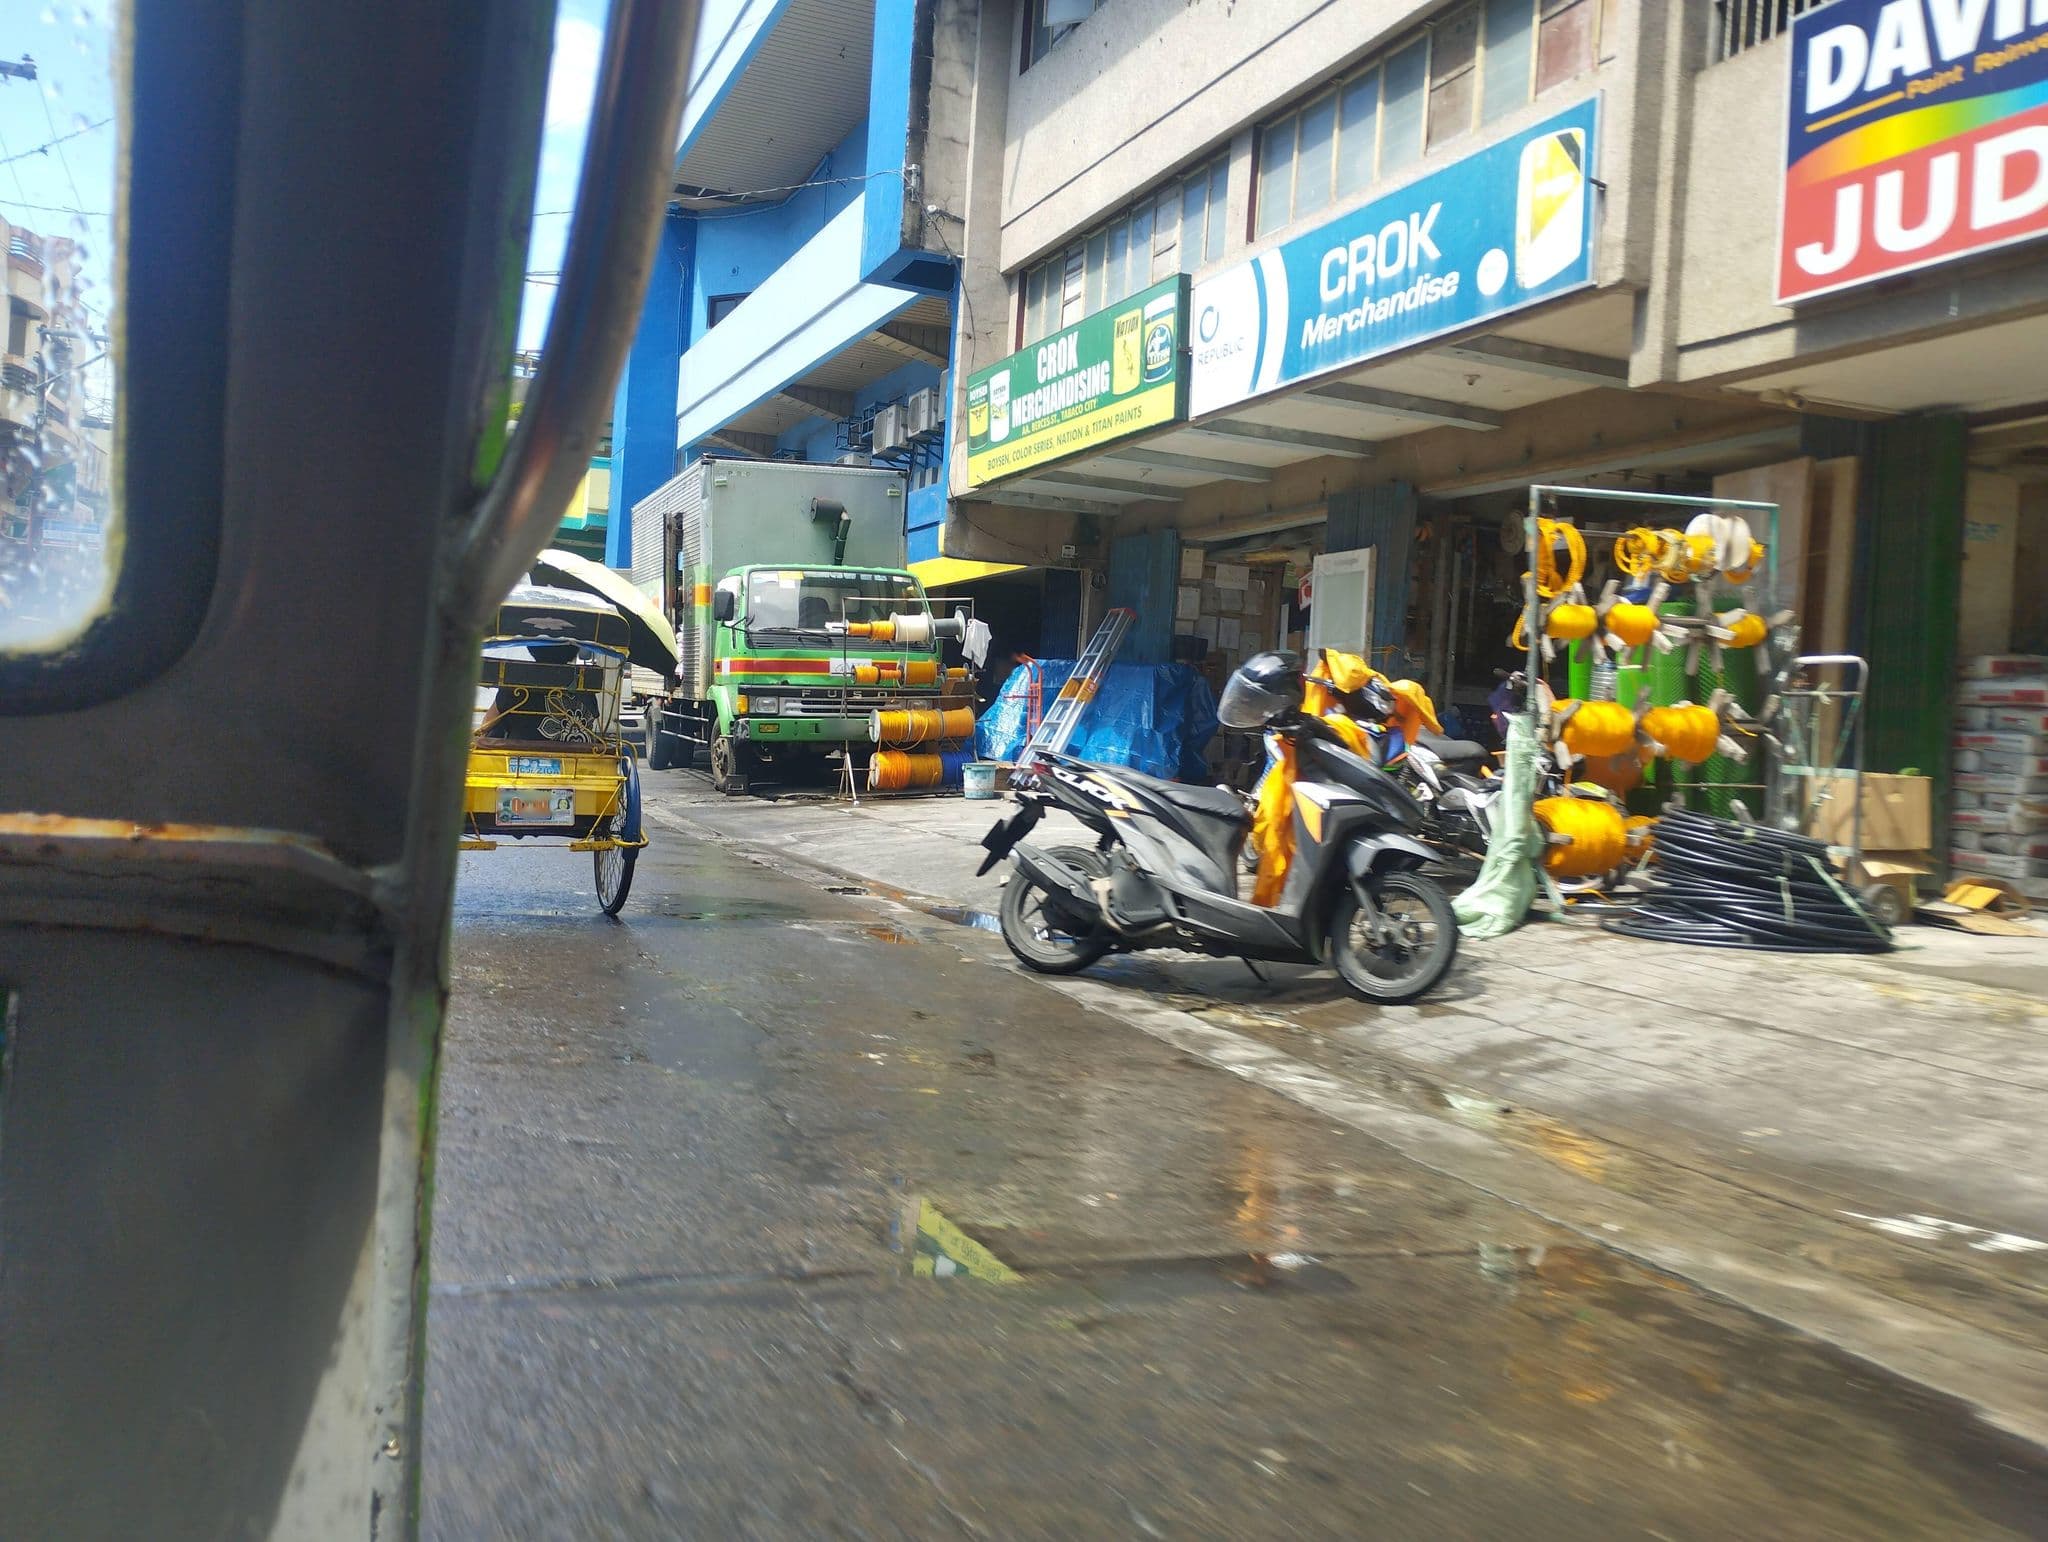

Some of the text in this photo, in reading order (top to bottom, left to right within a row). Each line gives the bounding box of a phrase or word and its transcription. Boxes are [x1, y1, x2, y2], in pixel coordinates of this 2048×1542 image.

[1805, 0, 2048, 115] DAVI
[1906, 65, 1965, 99] Paint
[1795, 125, 2048, 275] JUD
[1319, 202, 1443, 303] CROK
[1300, 271, 1460, 349] Merchandise
[1036, 331, 1079, 384] CROK
[1198, 336, 1246, 366] REPUBLIC
[1012, 360, 1111, 429] MERCHANDISING
[1012, 445, 1032, 462] COLOR
[1056, 427, 1083, 447] NATION
[1092, 415, 1114, 434] TITAN
[1115, 404, 1143, 426] PAINTS
[801, 689, 888, 698] FUSO
